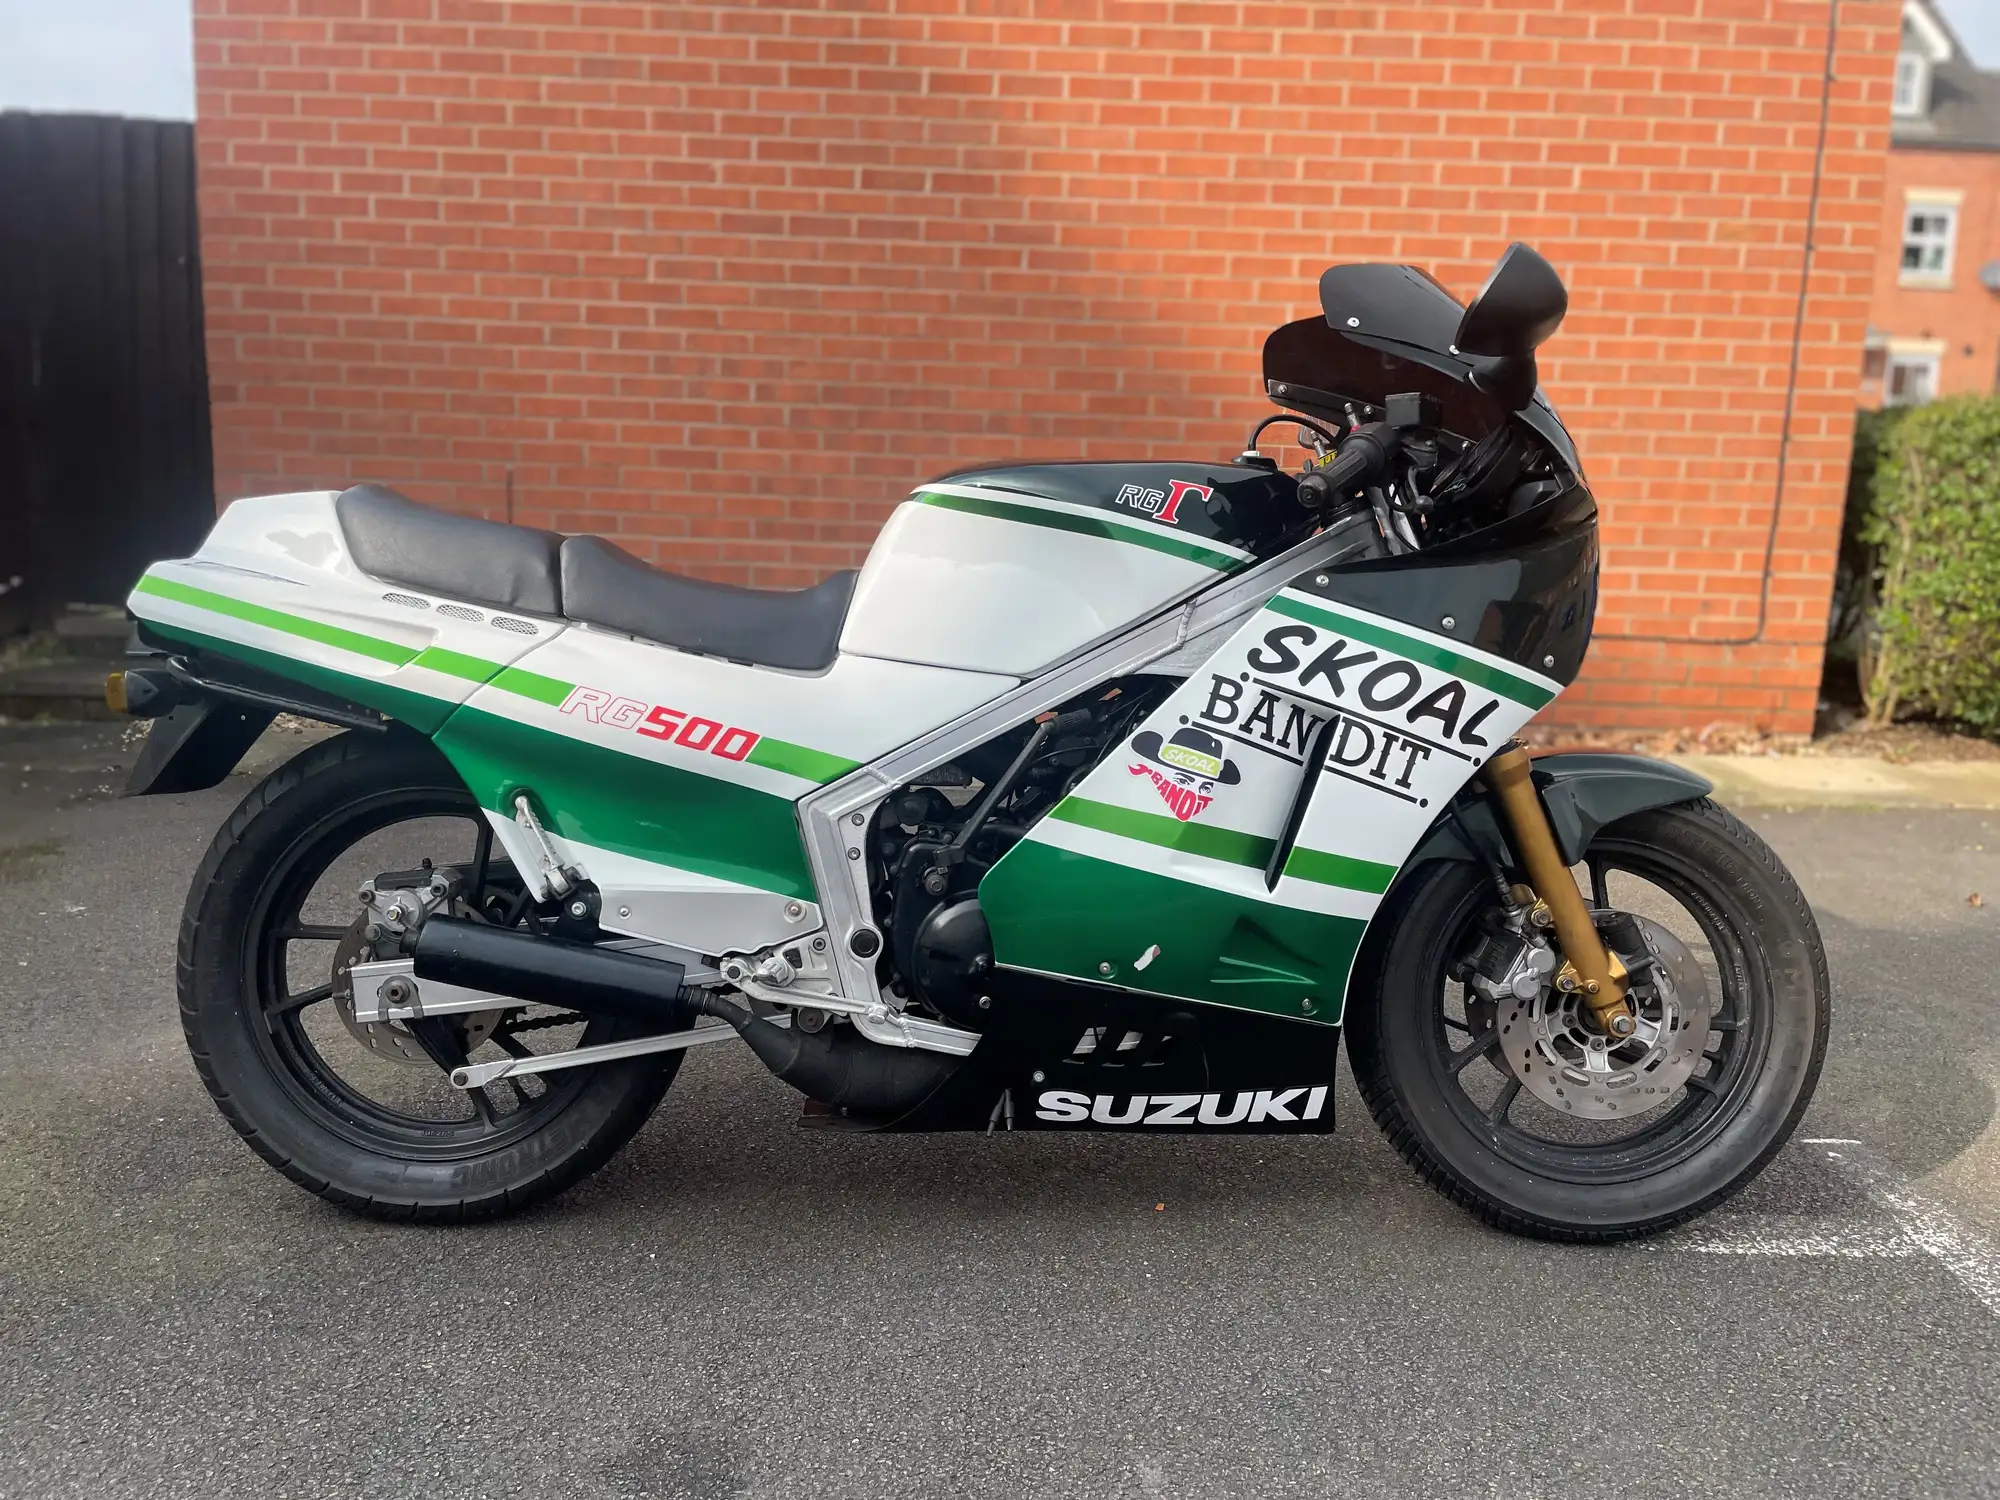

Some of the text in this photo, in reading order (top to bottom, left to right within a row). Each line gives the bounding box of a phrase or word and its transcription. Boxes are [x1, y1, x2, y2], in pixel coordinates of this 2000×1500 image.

[558, 685, 761, 762] RG500
[1246, 625, 1500, 747] SKOAL
[1164, 749, 1216, 773] SKOAL
[1199, 673, 1432, 789] BANDIT
[1035, 1085, 1329, 1125] SUZUKI
